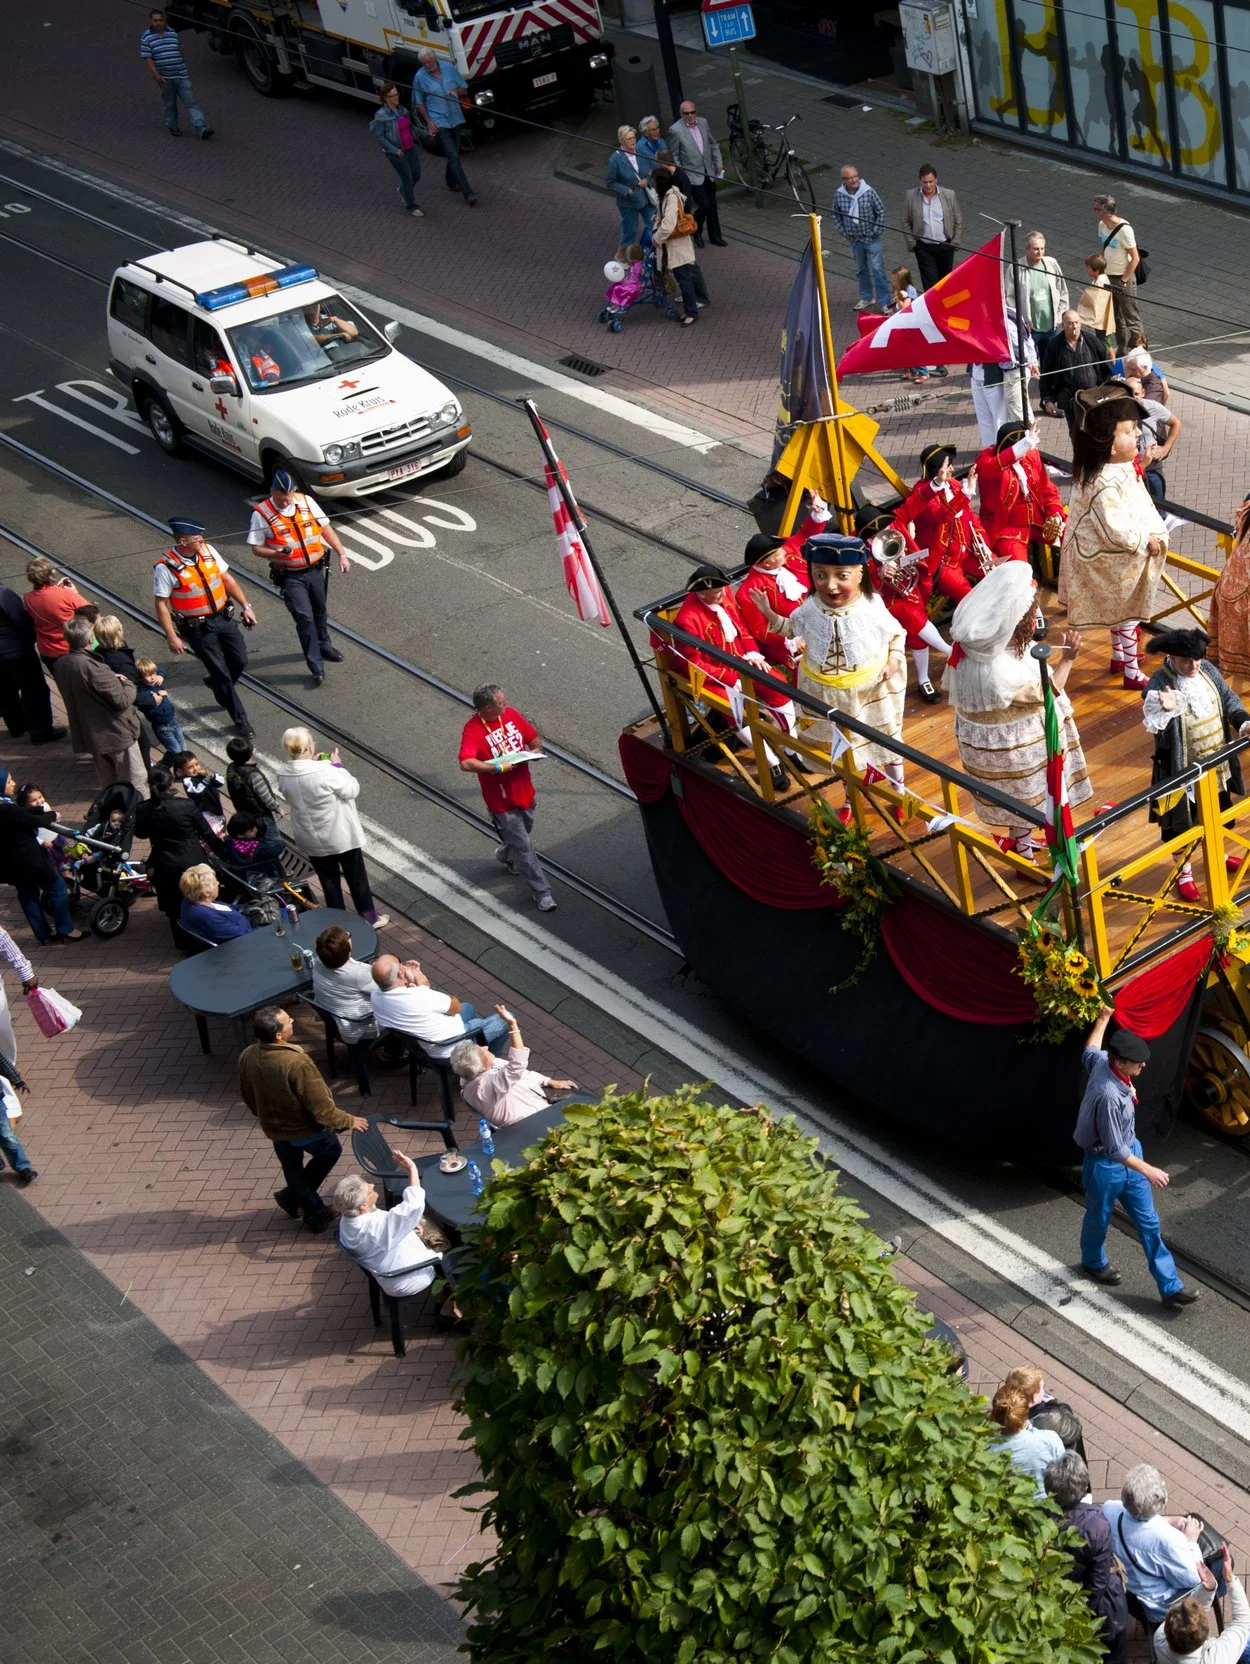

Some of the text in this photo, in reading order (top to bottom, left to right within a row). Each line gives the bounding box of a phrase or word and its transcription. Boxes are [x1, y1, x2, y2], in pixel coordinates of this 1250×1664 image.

[720, 12, 736, 21] TRAM
[725, 28, 737, 36] BUS
[518, 32, 551, 50] MAN
[332, 404, 358, 418] Rode
[357, 396, 386, 409] Kruis
[504, 720, 520, 737] JE
